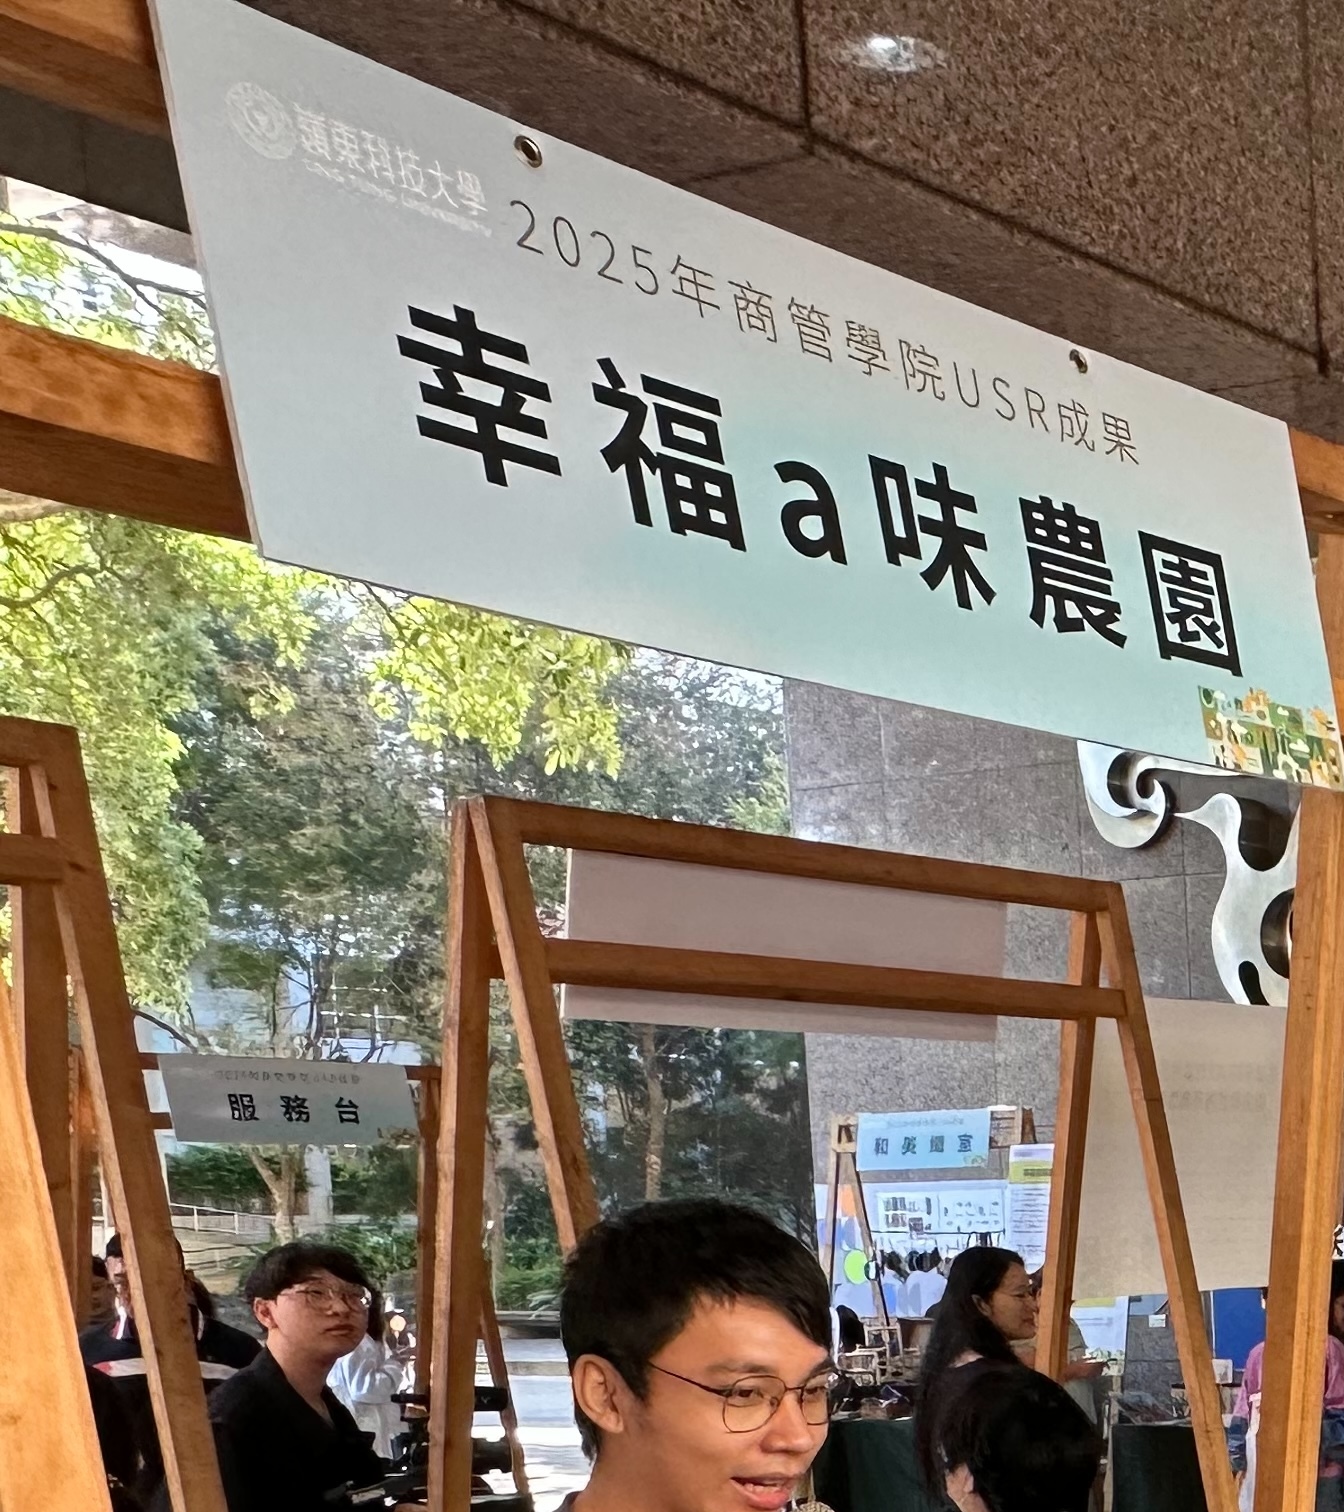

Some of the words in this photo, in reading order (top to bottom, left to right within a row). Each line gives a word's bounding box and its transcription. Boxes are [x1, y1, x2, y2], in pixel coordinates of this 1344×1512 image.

[509, 198, 1141, 466] 2025年商管學院USR成果
[396, 303, 1243, 677] 幸福a味農園
[227, 1093, 361, 1125] 服務台
